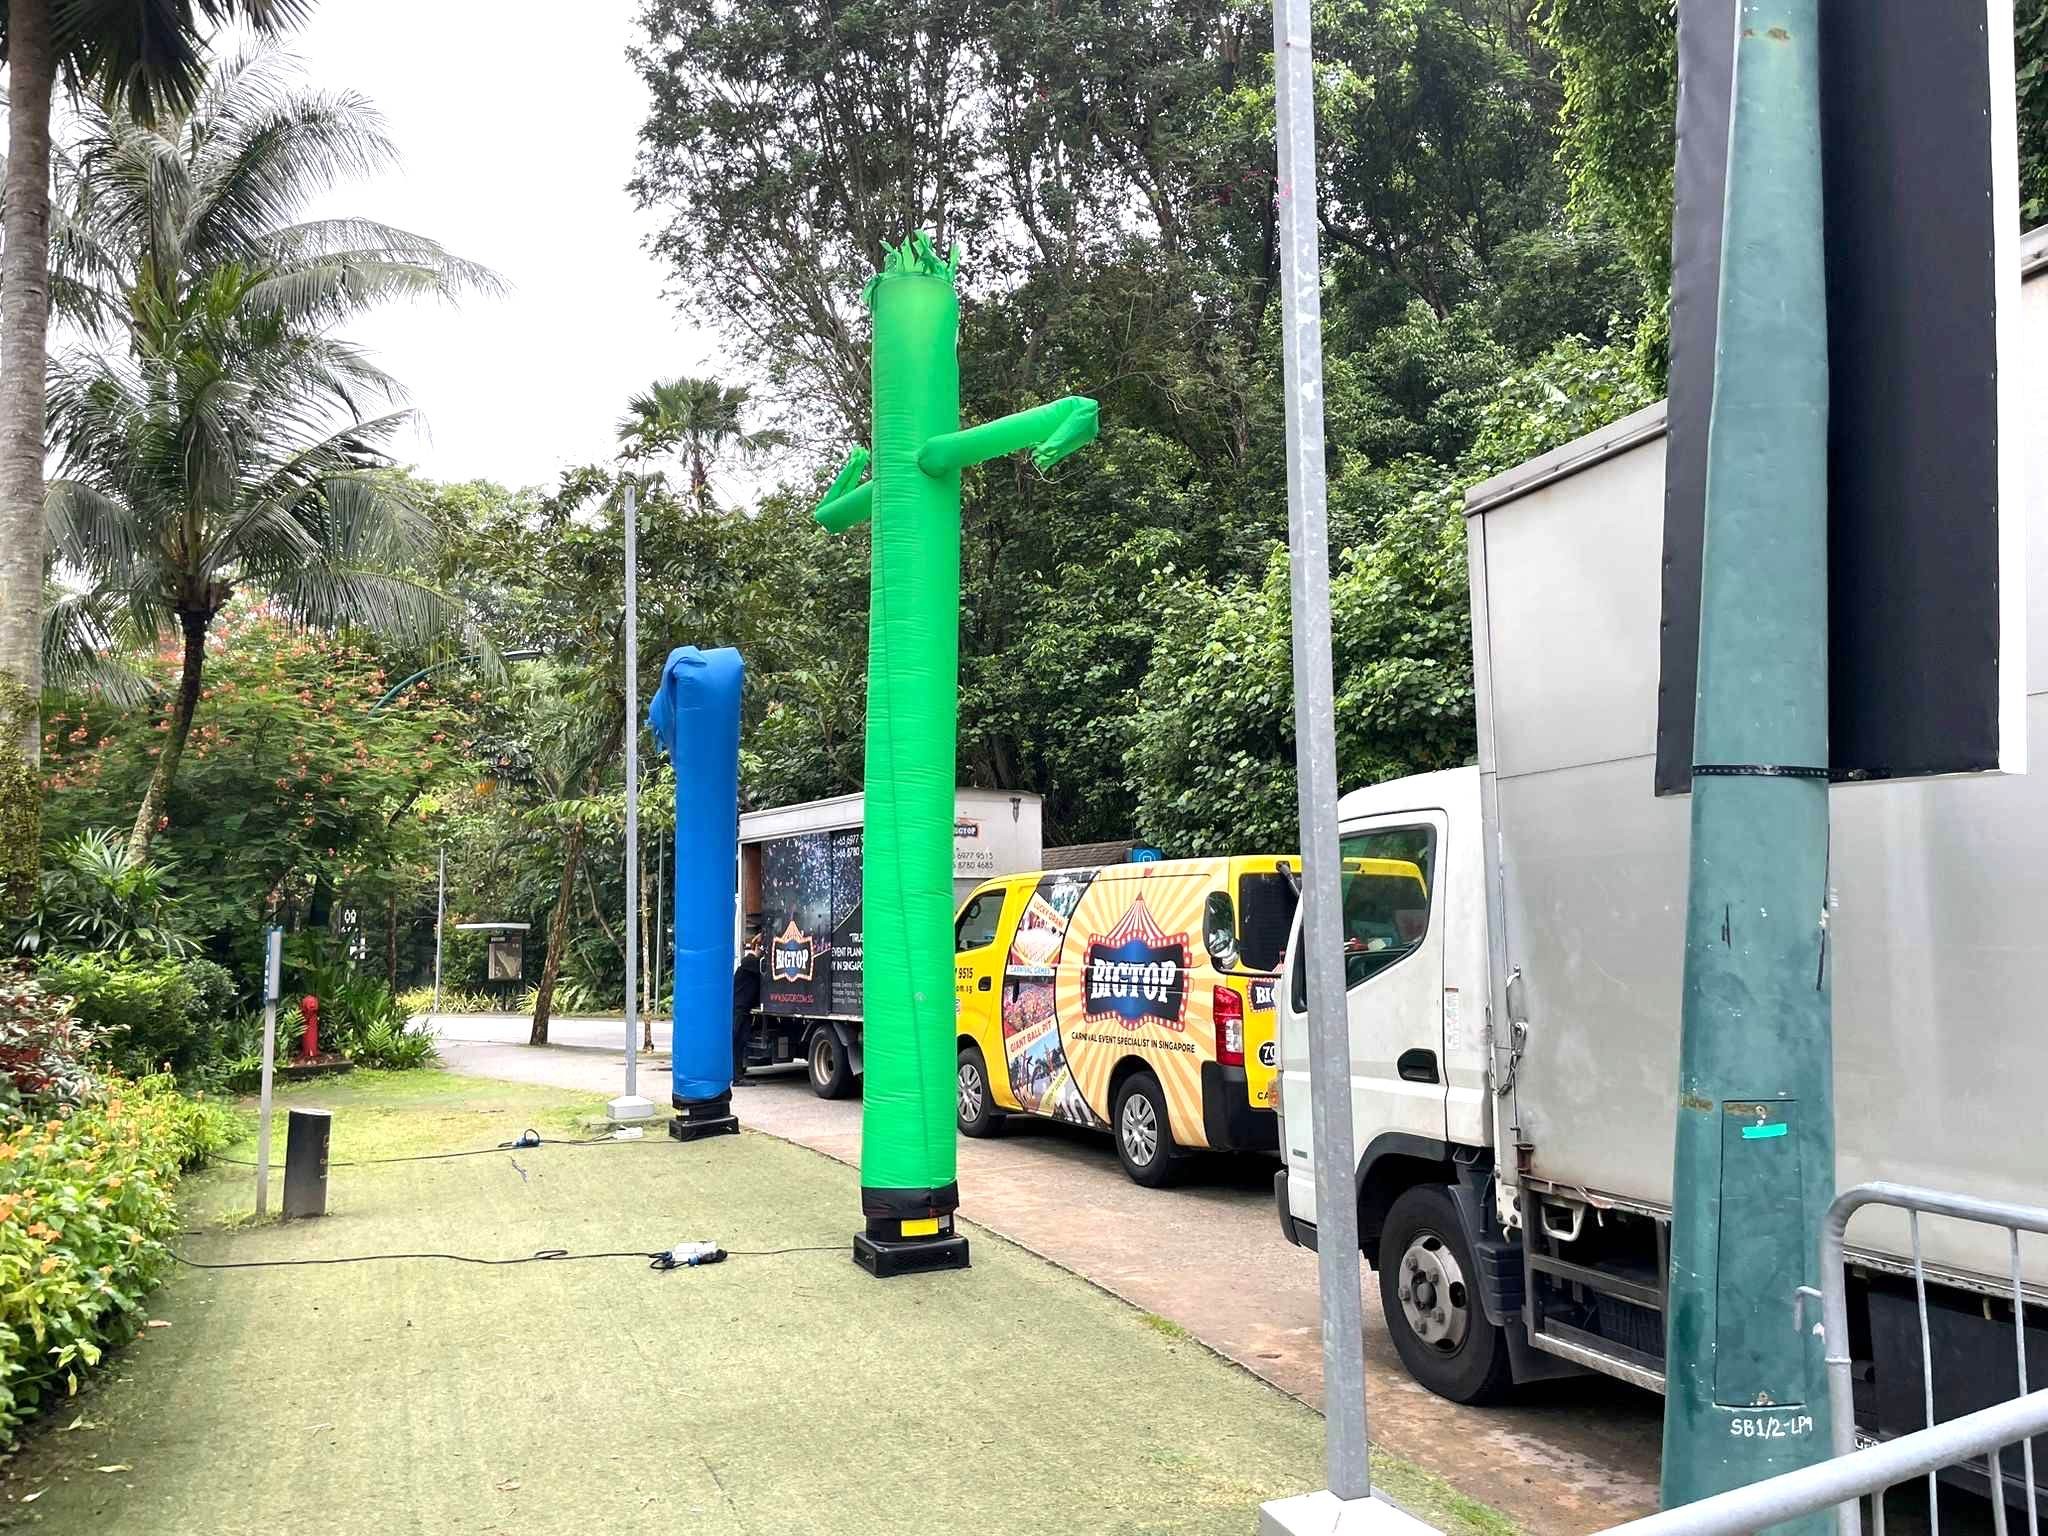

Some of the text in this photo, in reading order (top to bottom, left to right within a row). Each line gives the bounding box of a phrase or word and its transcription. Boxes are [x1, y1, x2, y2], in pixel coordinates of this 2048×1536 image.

[776, 949, 809, 969] BIGTOP
[1090, 958, 1177, 1003] BIGTOP
[1010, 1037, 1027, 1053] GIANT
[1026, 1030, 1041, 1042] BALL
[1071, 1031, 1196, 1053] CARNIVAL EVENT SPECIALIST IN SINGAPORE
